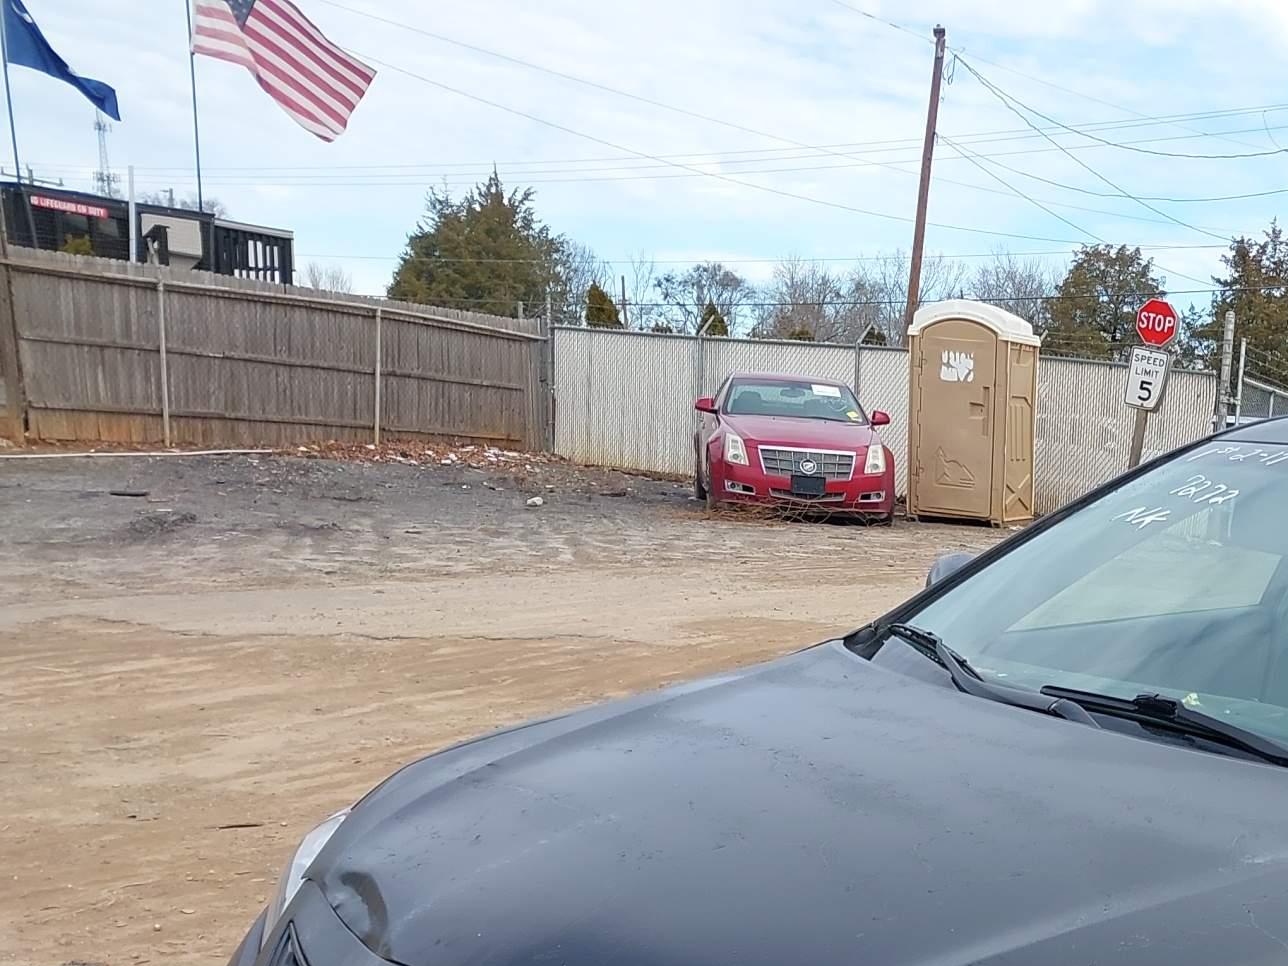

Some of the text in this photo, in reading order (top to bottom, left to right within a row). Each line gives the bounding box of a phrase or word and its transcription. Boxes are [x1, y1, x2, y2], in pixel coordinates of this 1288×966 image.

[1139, 311, 1174, 333] STOP
[1134, 353, 1165, 368] SPEED
[1135, 366, 1160, 379] LIMIT
[1137, 380, 1153, 402] 5
